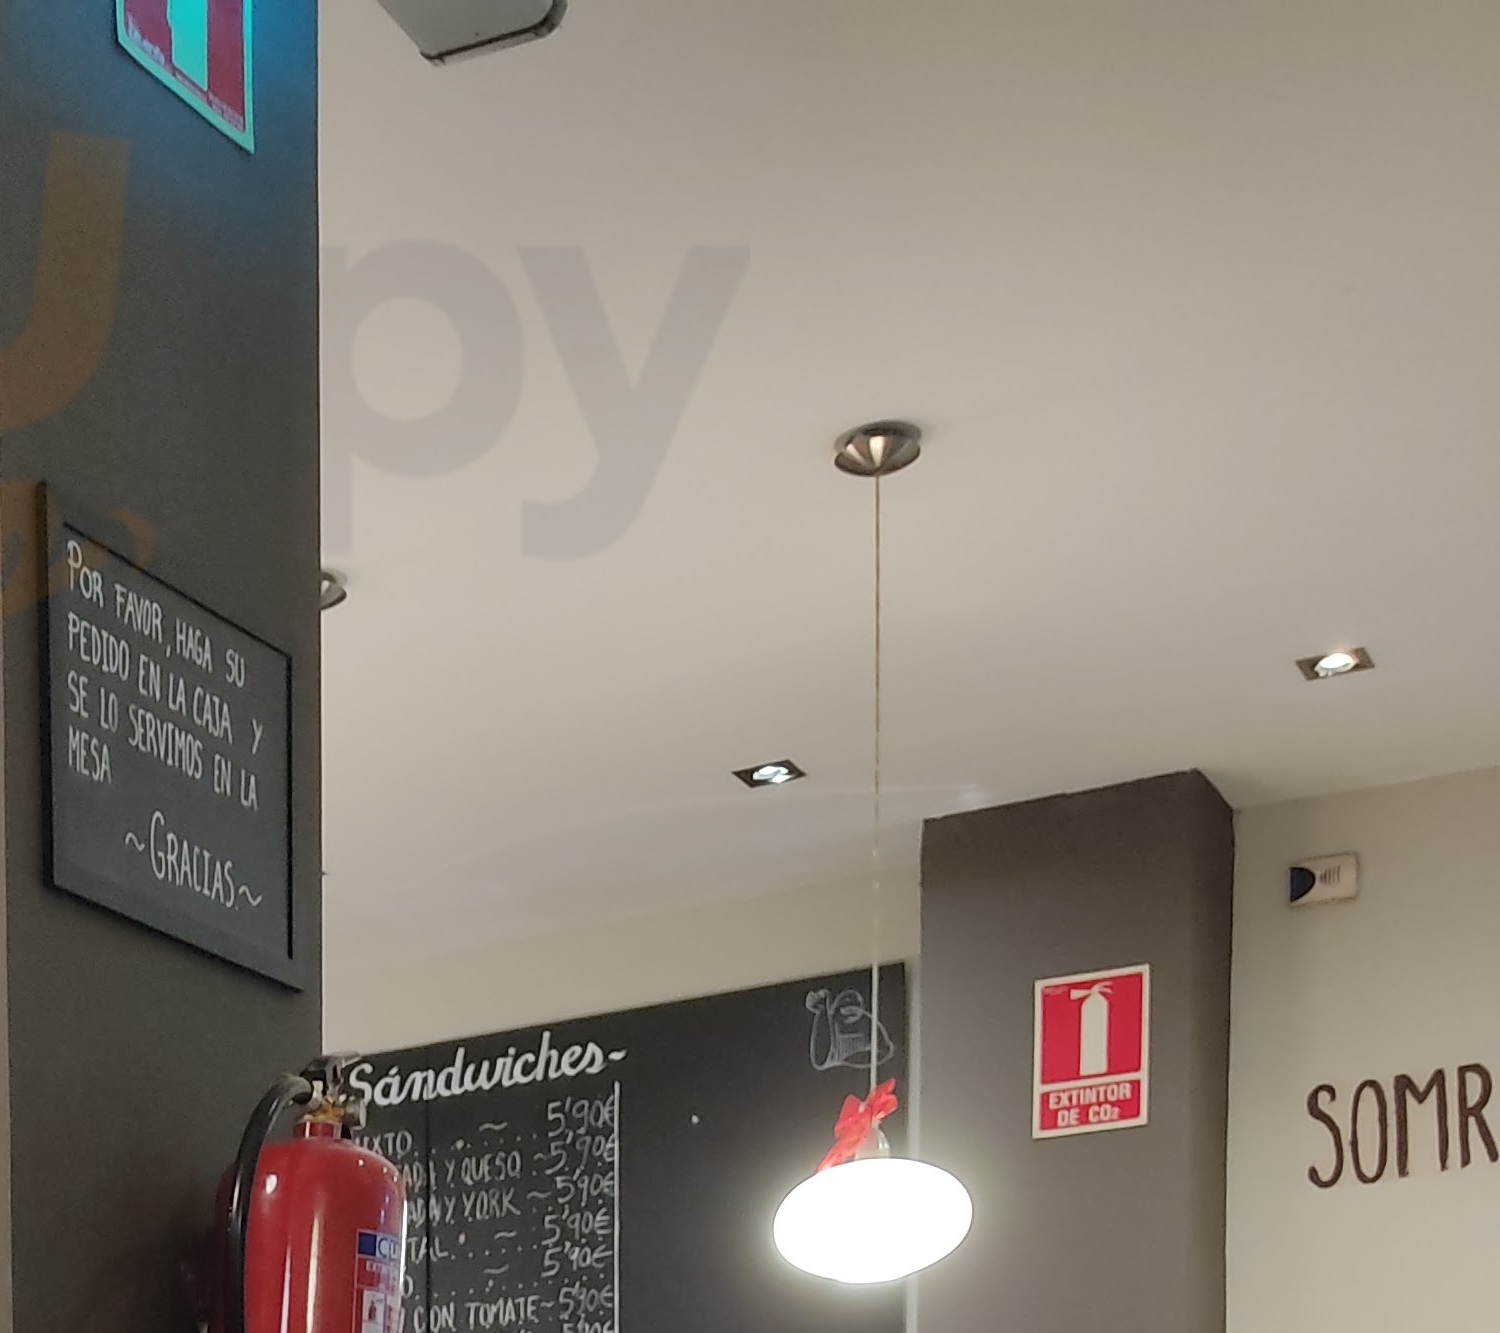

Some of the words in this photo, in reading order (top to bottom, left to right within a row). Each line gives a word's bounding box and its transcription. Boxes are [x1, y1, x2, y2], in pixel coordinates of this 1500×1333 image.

[66, 540, 104, 608] POR
[176, 617, 213, 673] HAGA
[225, 648, 246, 688] SU
[68, 611, 130, 682] PEDIDO
[139, 654, 161, 698] EN
[167, 672, 189, 717] LA
[193, 686, 233, 745] CAJA
[250, 718, 264, 756] Y
[67, 670, 89, 719] SE
[100, 687, 119, 734] LO
[128, 703, 204, 780] SERVIMOS
[213, 753, 231, 797] EN
[241, 768, 258, 812] LA
[67, 725, 112, 785] MESA
[1048, 1082, 1132, 1110] EXTINTOR
[1057, 1108, 1080, 1127] DE
[461, 1151, 522, 1185] QUESO
[462, 1187, 521, 1222] YORK
[465, 1296, 541, 1331] TOMATE
